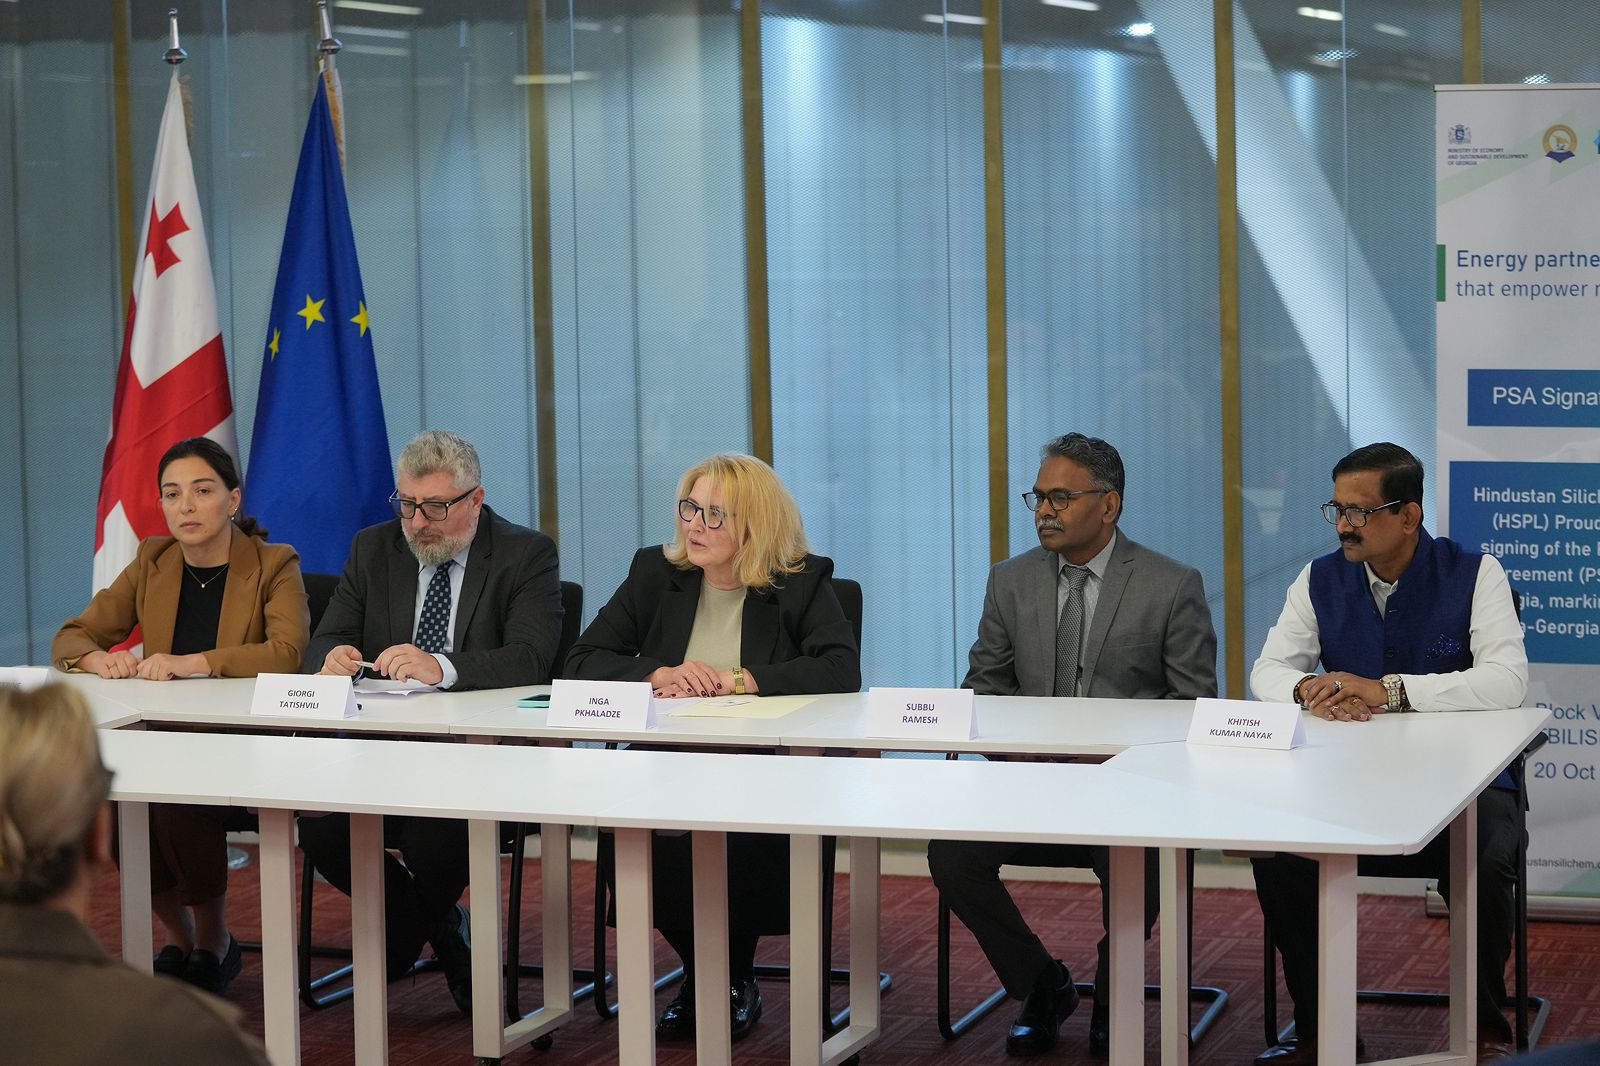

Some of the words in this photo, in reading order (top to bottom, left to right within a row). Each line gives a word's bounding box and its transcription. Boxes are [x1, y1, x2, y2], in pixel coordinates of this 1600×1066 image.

[1457, 250, 1528, 272] Energy
[1535, 251, 1600, 272] partne
[1456, 280, 1495, 297] that
[1501, 283, 1588, 300] empower
[1493, 386, 1537, 405] PSA
[1542, 387, 1600, 410] Signa
[1474, 487, 1556, 503] Hindustan
[1492, 512, 1549, 532] (HSPL)
[1481, 539, 1539, 559] signing
[1544, 540, 1561, 555] of
[1565, 541, 1591, 555] the
[287, 689, 315, 698] GIORGI
[279, 700, 320, 709] TATISHVILI
[589, 697, 610, 706] INGA
[906, 703, 935, 711] SUBBU
[574, 709, 621, 719] PKHALADZE
[902, 715, 938, 724] RAMESH
[1227, 718, 1261, 727] KHITISH
[1209, 728, 1242, 738] KUMAR
[1243, 731, 1273, 740] NAYAK
[1542, 728, 1600, 745] BILIS
[1534, 762, 1557, 779] 20
[1563, 762, 1596, 780] Oct
